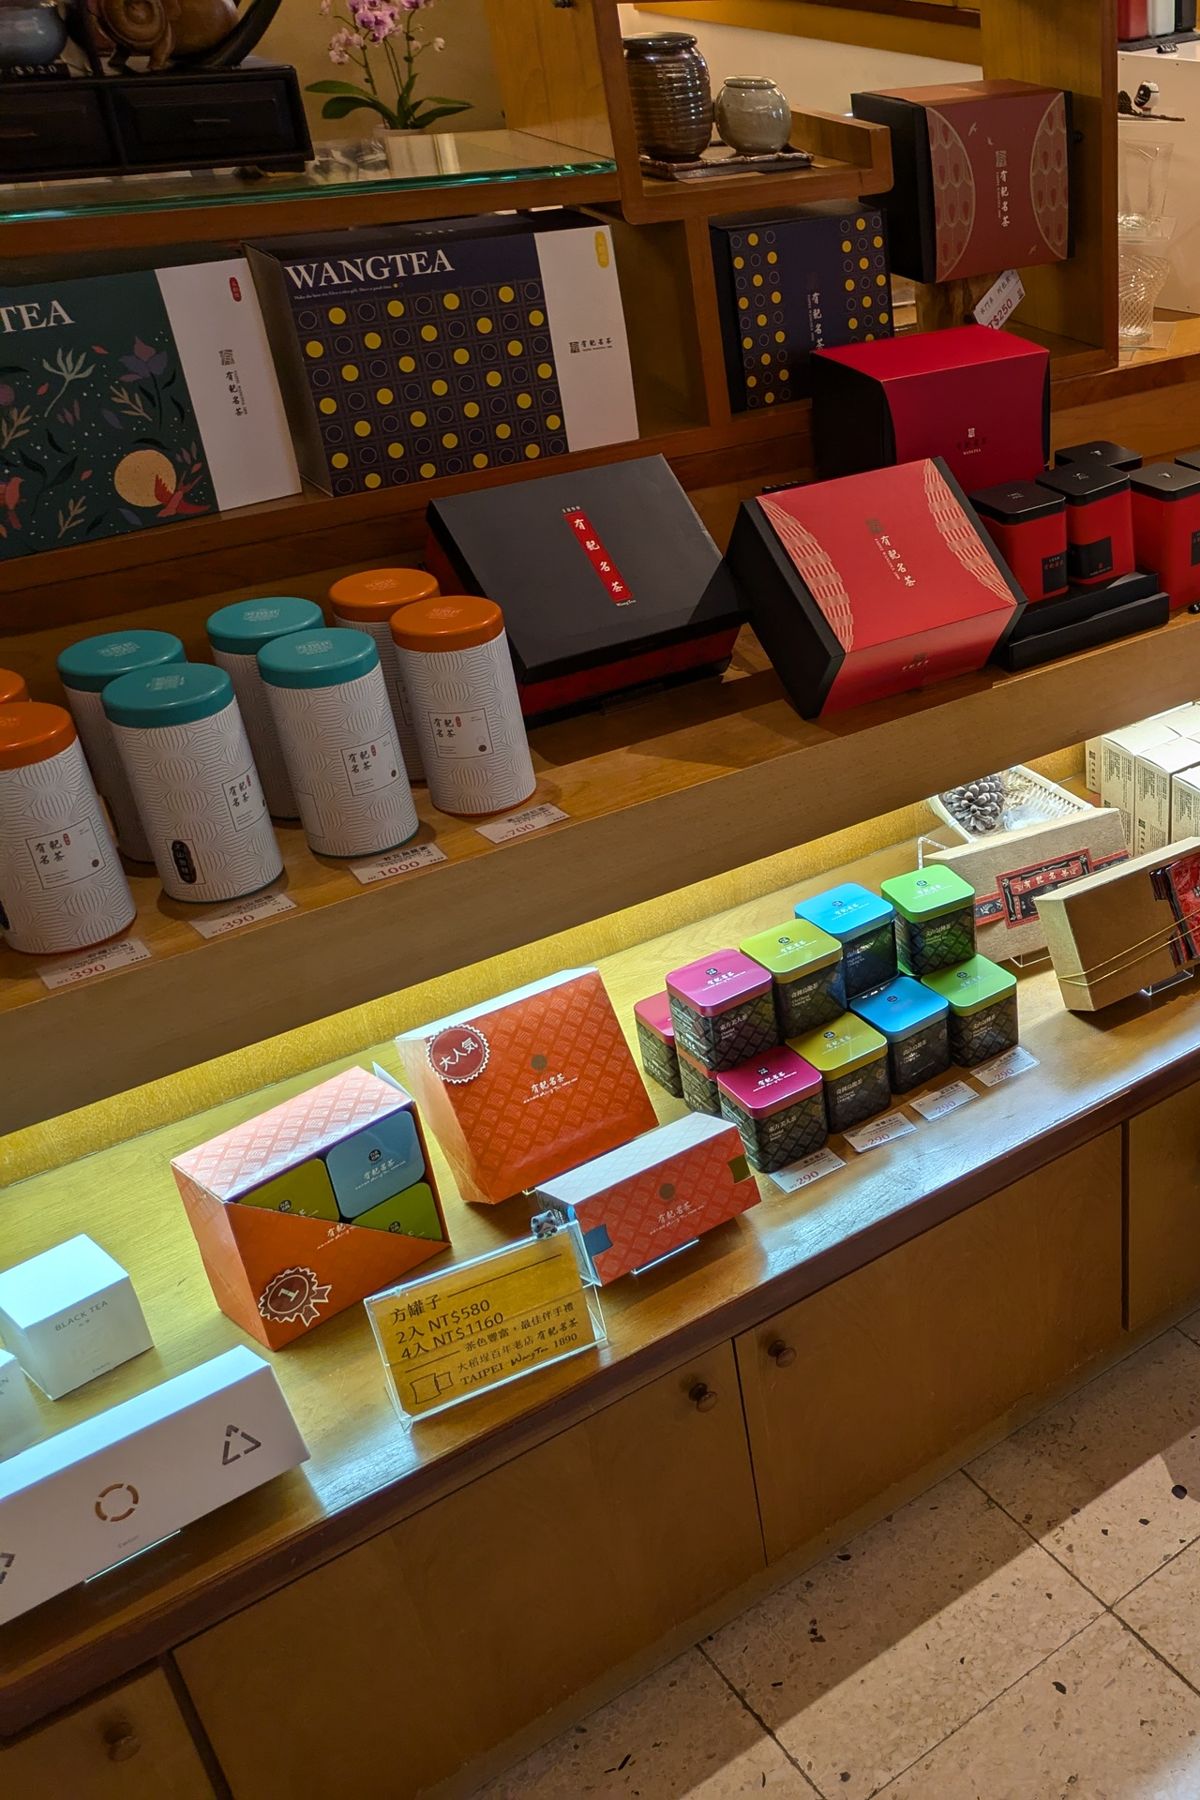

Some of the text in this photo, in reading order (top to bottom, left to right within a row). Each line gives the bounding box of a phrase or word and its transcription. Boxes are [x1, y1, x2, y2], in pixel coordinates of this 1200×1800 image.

[284, 249, 455, 289] WANGTEA
[0, 300, 76, 333] TEA
[440, 1037, 478, 1072] 大人気
[55, 1311, 88, 1331] BLACK
[90, 1300, 108, 1313] TEA
[390, 1294, 441, 1325] 方罐子
[428, 1299, 490, 1332] NT$580
[433, 1312, 503, 1348] NT$1160
[460, 1362, 504, 1385] TAIPEI
[554, 1332, 578, 1349] 1890
